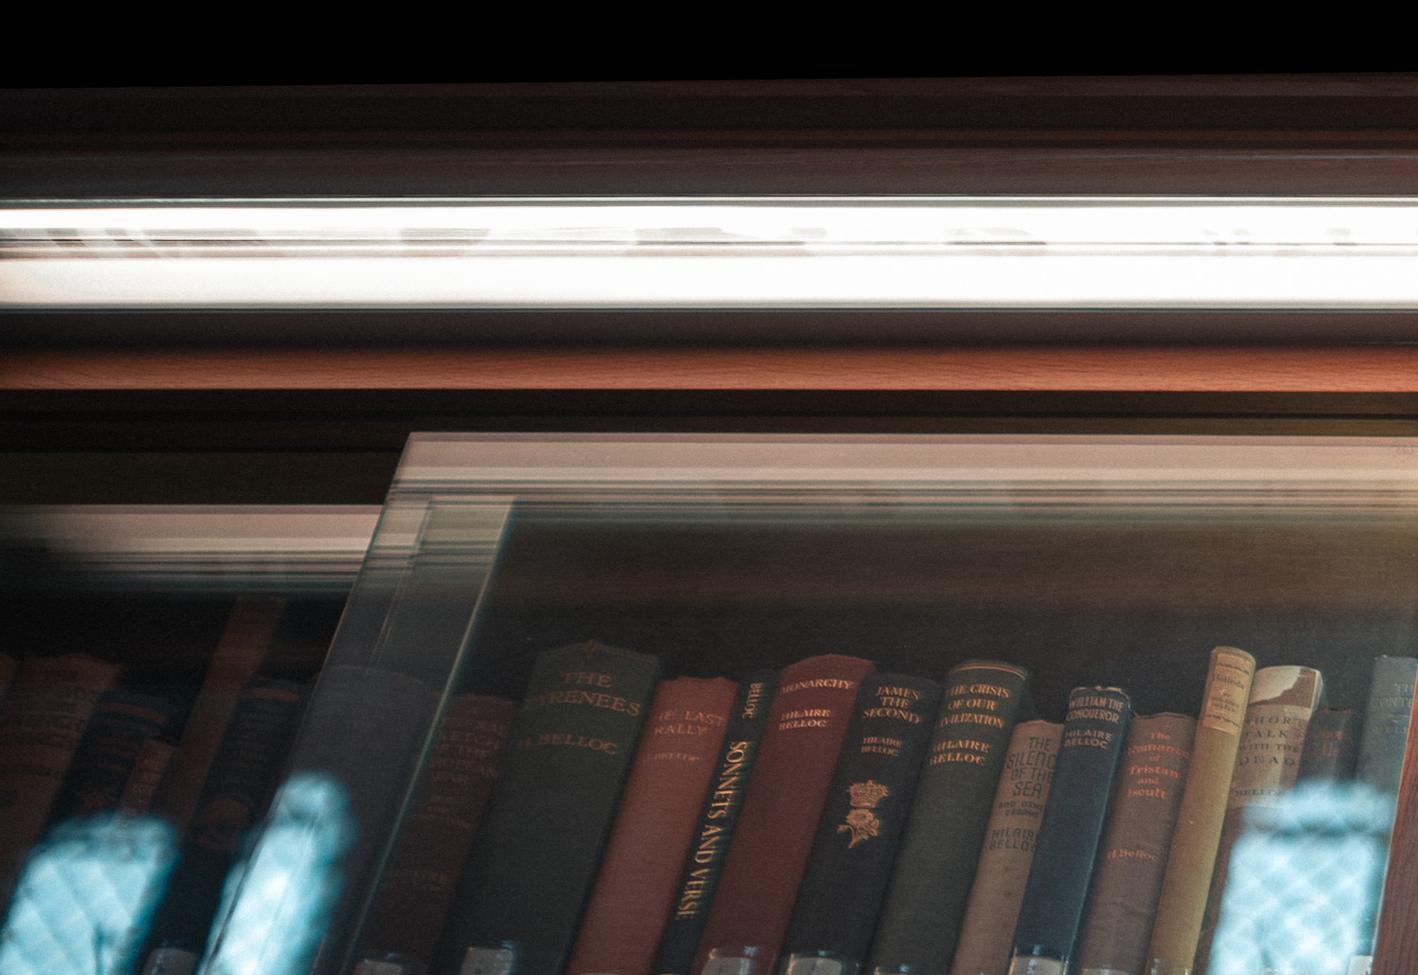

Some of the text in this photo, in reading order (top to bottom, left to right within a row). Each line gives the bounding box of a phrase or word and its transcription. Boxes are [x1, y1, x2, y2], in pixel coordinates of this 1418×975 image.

[560, 671, 613, 688] THE
[782, 679, 855, 694] MONARCHY
[876, 686, 921, 700] JAMES
[969, 684, 1011, 698] CRISIS
[880, 696, 910, 709] THE
[947, 699, 998, 710] OF OUR
[1110, 698, 1125, 712] THE
[685, 711, 724, 726] LAST
[782, 709, 831, 720] HILAIRE
[862, 708, 920, 724] SECOND
[1066, 709, 1120, 725] CONQUEROR
[779, 720, 828, 730] BELLOC
[1065, 729, 1113, 741] HILAIRE
[1151, 732, 1170, 741] The
[1029, 737, 1052, 752] THE
[1064, 738, 1109, 749] BELLOC
[928, 752, 986, 766] BELLOC
[1239, 756, 1296, 767] DEAD
[1011, 768, 1028, 781] OF
[1129, 765, 1181, 779] Tristan
[1137, 777, 1160, 785] and
[1013, 782, 1043, 799] SEA
[676, 740, 748, 920] SONNETS AND VERSE
